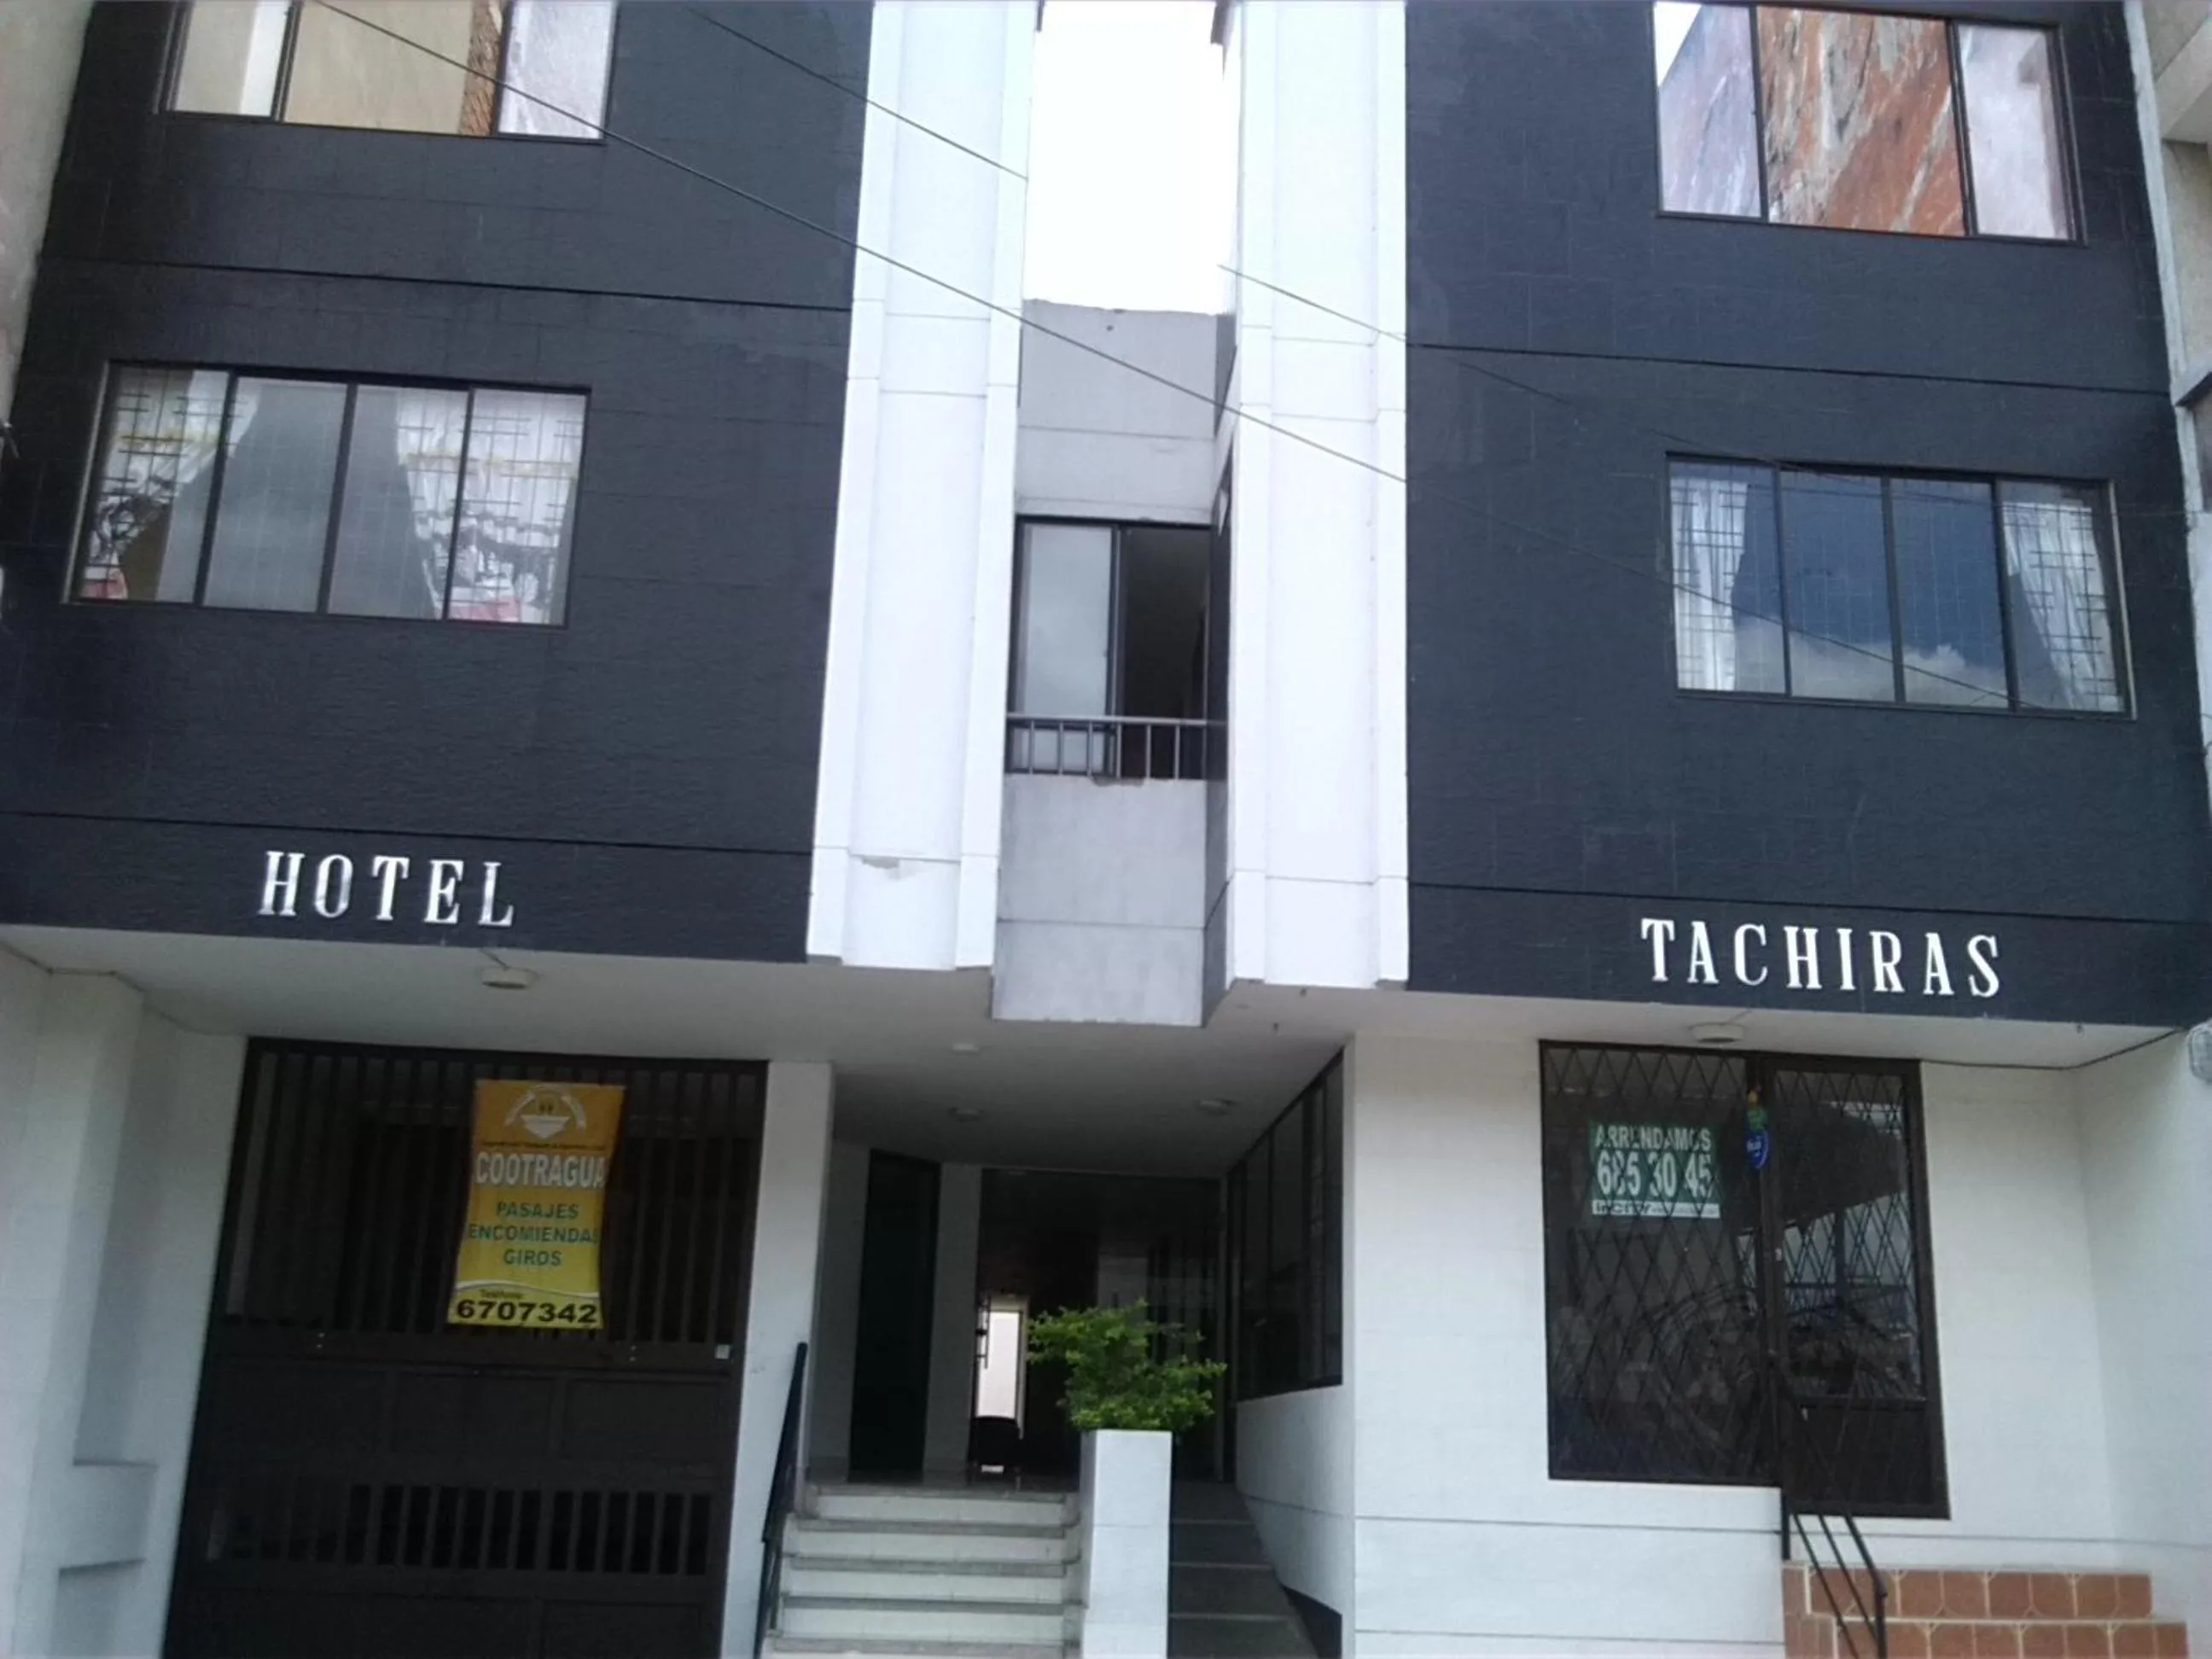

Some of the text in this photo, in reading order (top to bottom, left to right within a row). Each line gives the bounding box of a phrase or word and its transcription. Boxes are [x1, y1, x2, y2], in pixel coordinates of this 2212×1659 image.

[258, 851, 514, 927] HOTEL
[1641, 917, 2000, 998] TACHIRAS
[475, 1152, 606, 1188] COOTRAGUA
[1648, 1152, 1678, 1197] 30
[1685, 1152, 1713, 1198] 45
[496, 1201, 580, 1219] PASAJES
[503, 1249, 562, 1266] GIROS
[457, 1300, 597, 1324] 6707342
